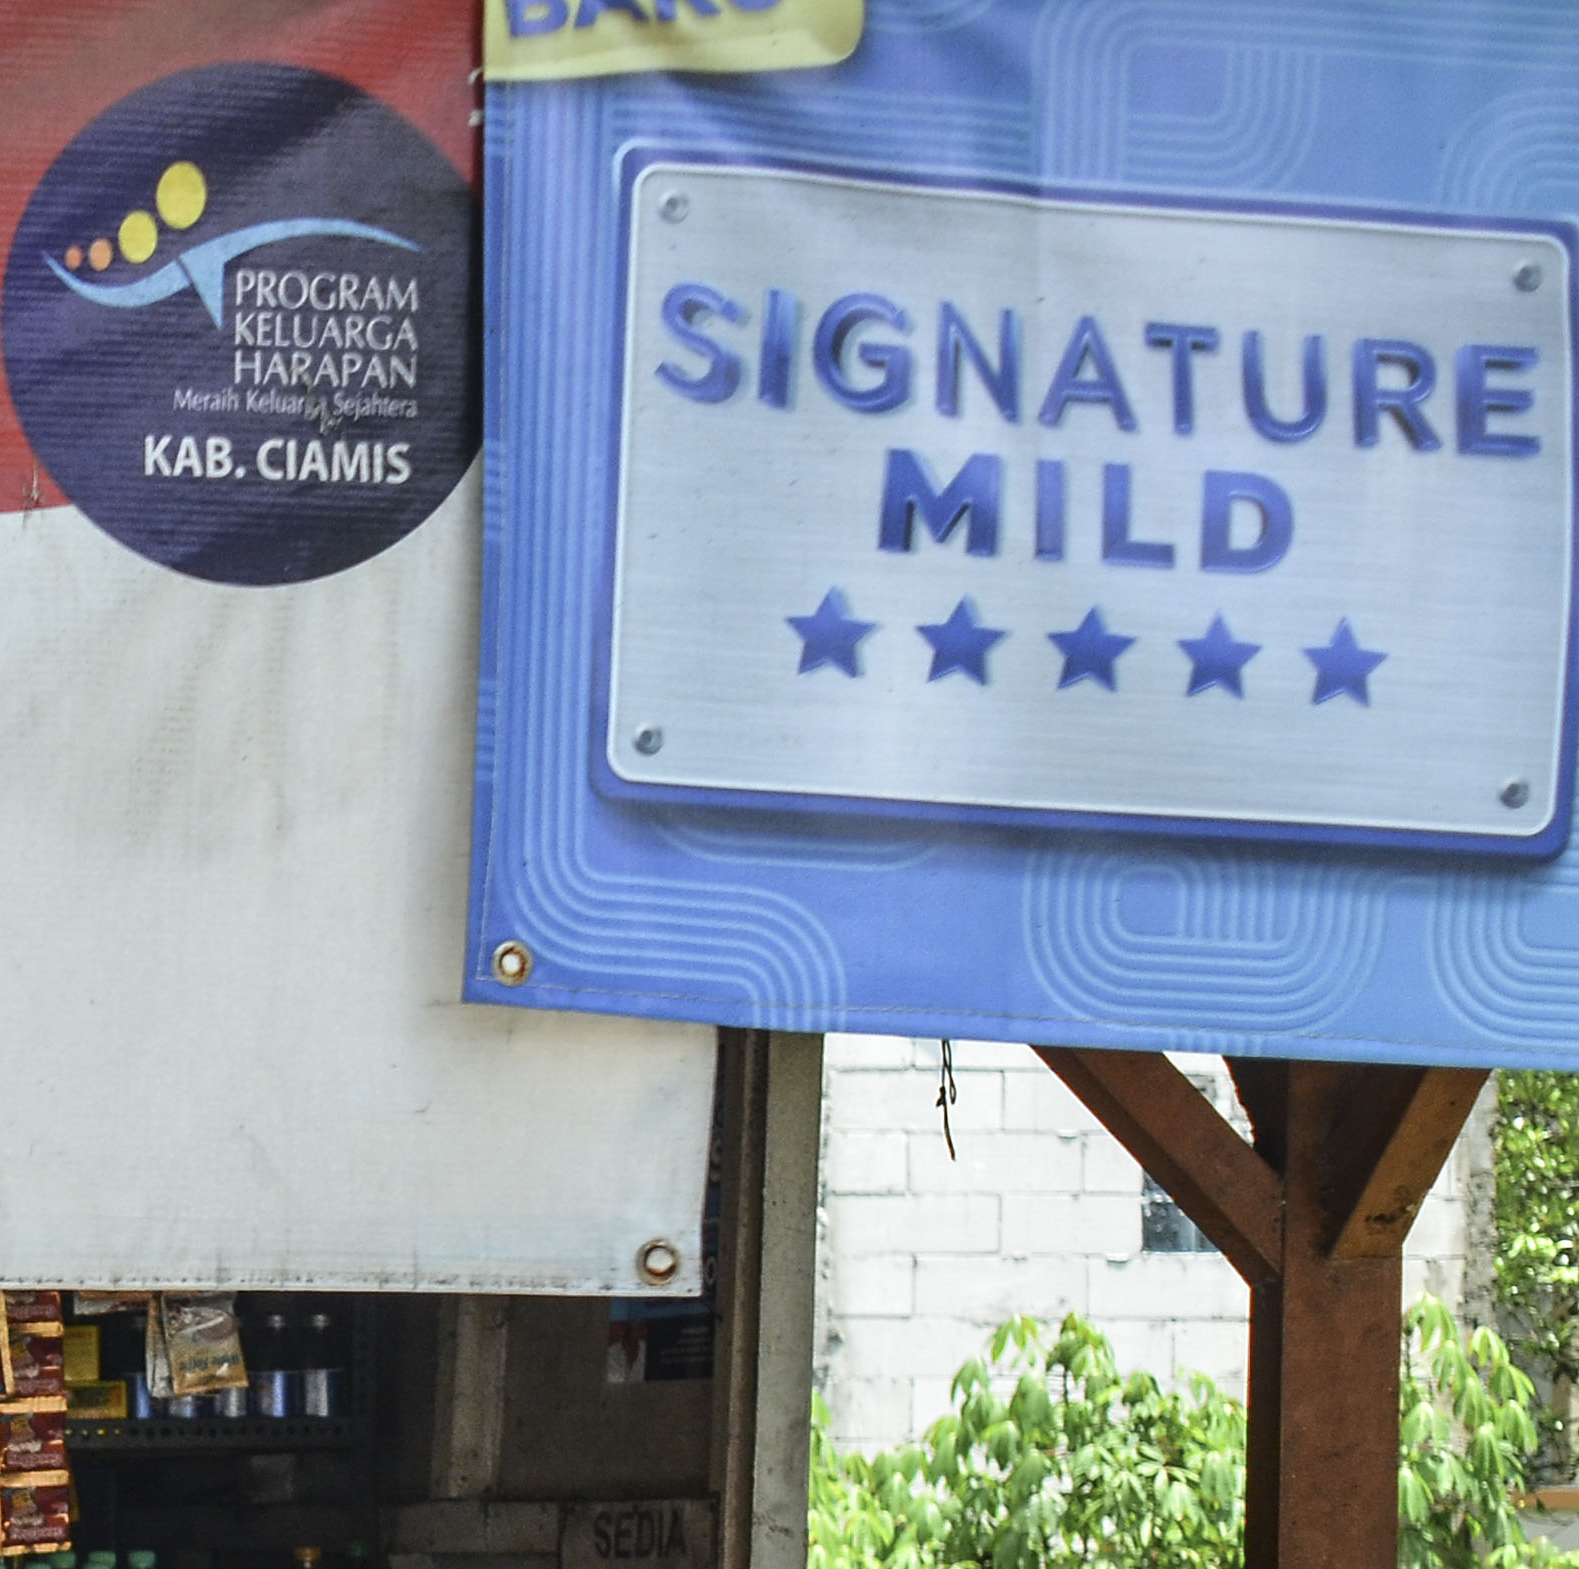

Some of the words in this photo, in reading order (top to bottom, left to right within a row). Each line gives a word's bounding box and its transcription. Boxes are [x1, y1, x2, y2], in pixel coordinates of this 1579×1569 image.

[234, 268, 419, 311] PROGRAM
[234, 312, 419, 351] KELUARGA
[233, 349, 418, 388] HARAPAN
[655, 280, 1544, 457] SIGNATURE
[173, 389, 239, 412] Meraih
[246, 389, 329, 421] Keluarga
[332, 391, 418, 419] Sejahtera
[144, 434, 246, 479] KAB.
[255, 438, 412, 484] CIAMIS
[878, 447, 1295, 575] MILD
[593, 1509, 686, 1558] SEDIA
